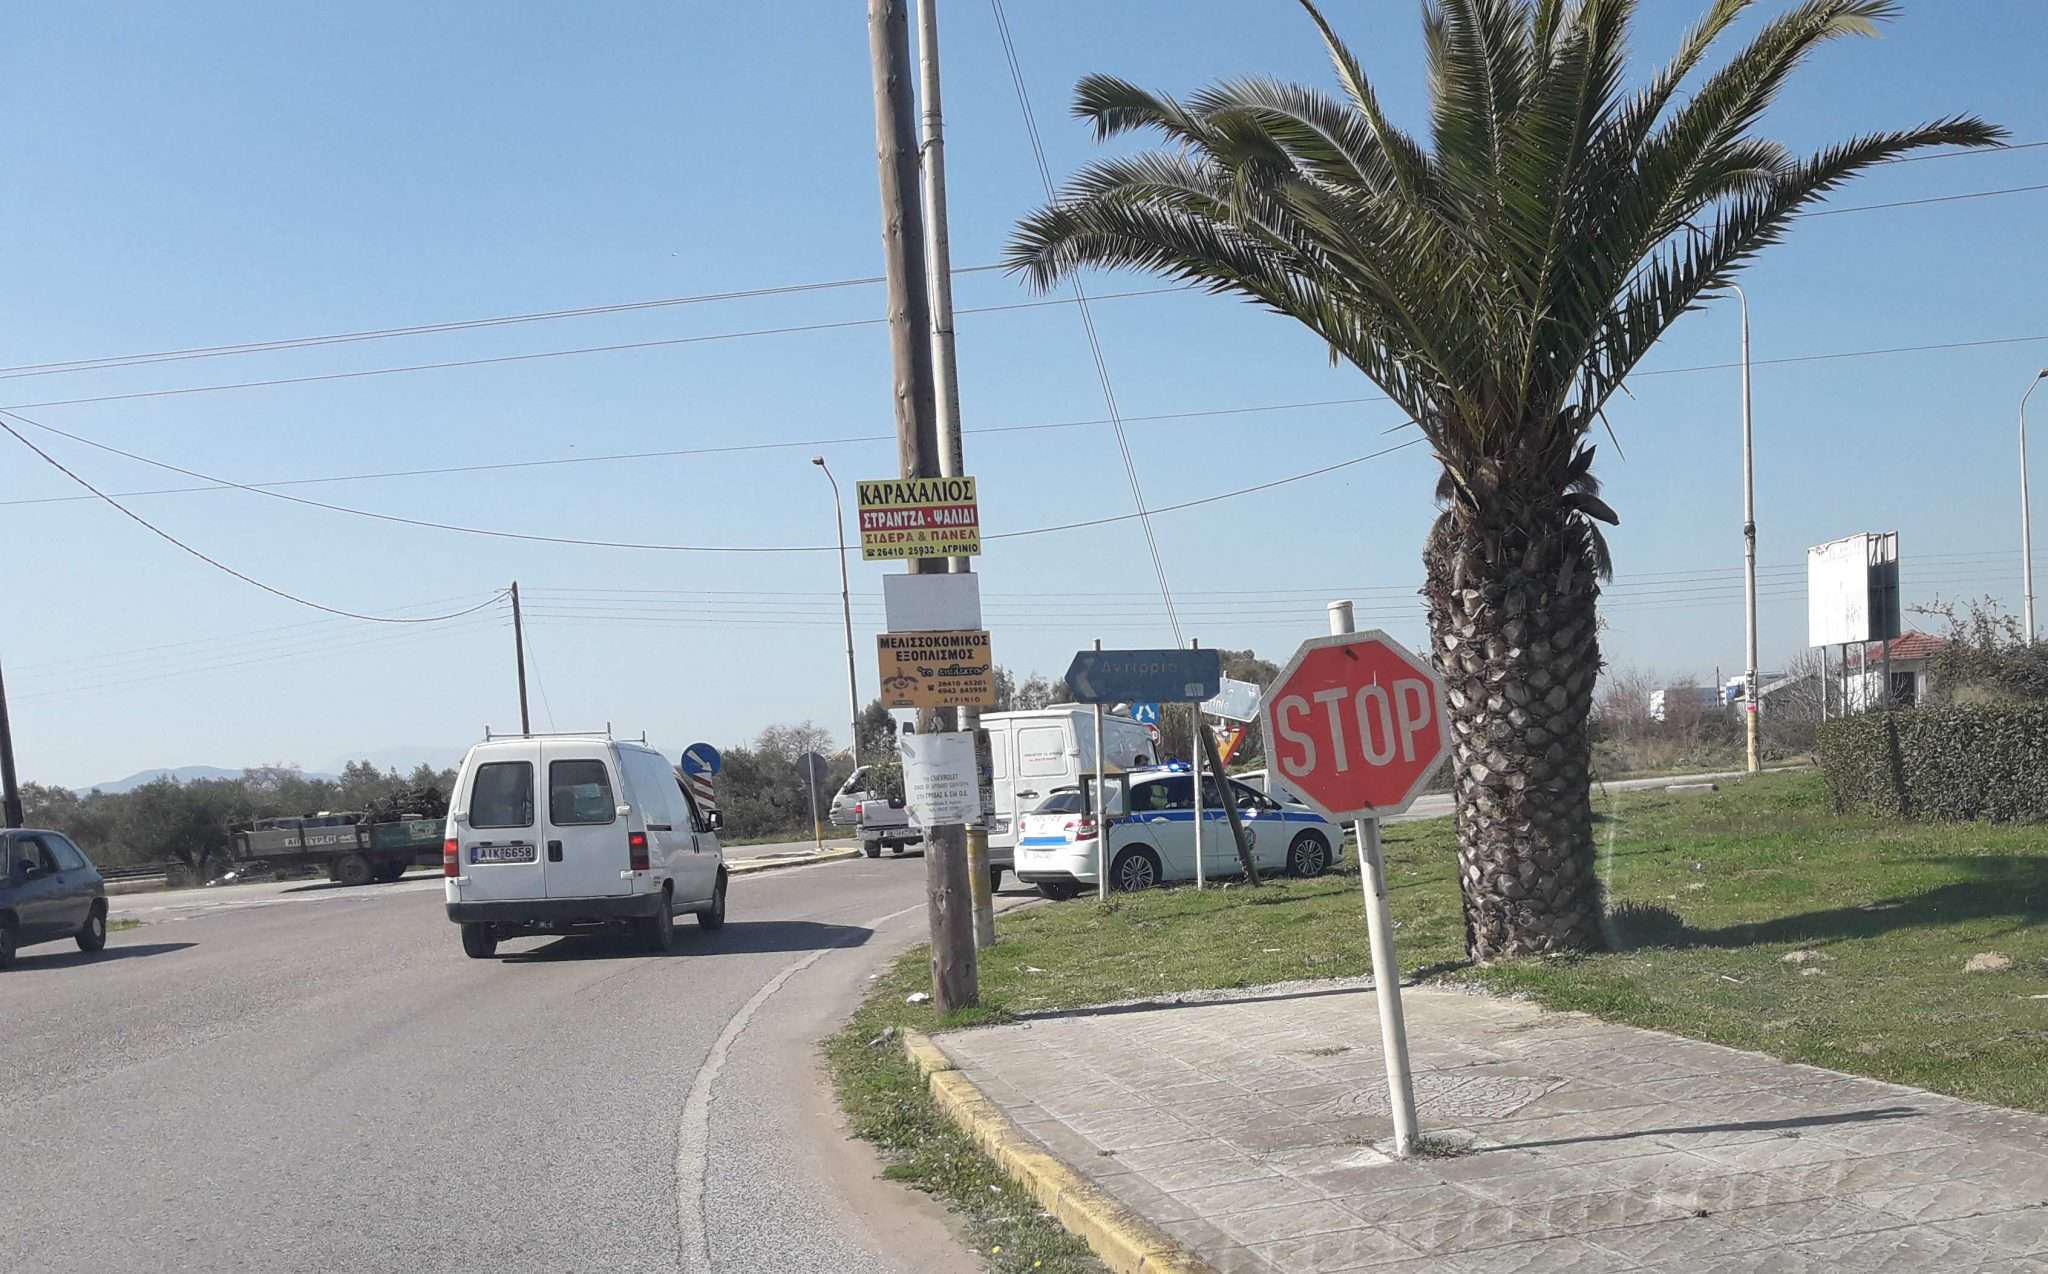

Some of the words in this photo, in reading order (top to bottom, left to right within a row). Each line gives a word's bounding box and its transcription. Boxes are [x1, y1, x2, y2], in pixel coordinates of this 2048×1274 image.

[860, 480, 973, 505] ΚΑΡΑΧΑΛΙΟΣ
[864, 510, 925, 529] ΣΤΡΑΝΤΖΑ
[934, 508, 975, 525] ΨΑΛΙΔΙ
[865, 532, 914, 544] ΣΙΔΕΡΑ
[918, 531, 927, 542] &
[931, 529, 976, 541] ΠΑΝΕΛ
[877, 547, 904, 557] 26410
[942, 543, 978, 553] ΑΓΡΙΝΙΟ
[880, 635, 989, 649] ΜΕΛΙΣΣΟΚΟΜΙΚΟΣ
[895, 649, 975, 661] ΕΞΟΠΛΙΣΜΟΣ
[1277, 679, 1432, 777] STOP
[505, 847, 532, 858] 6658
